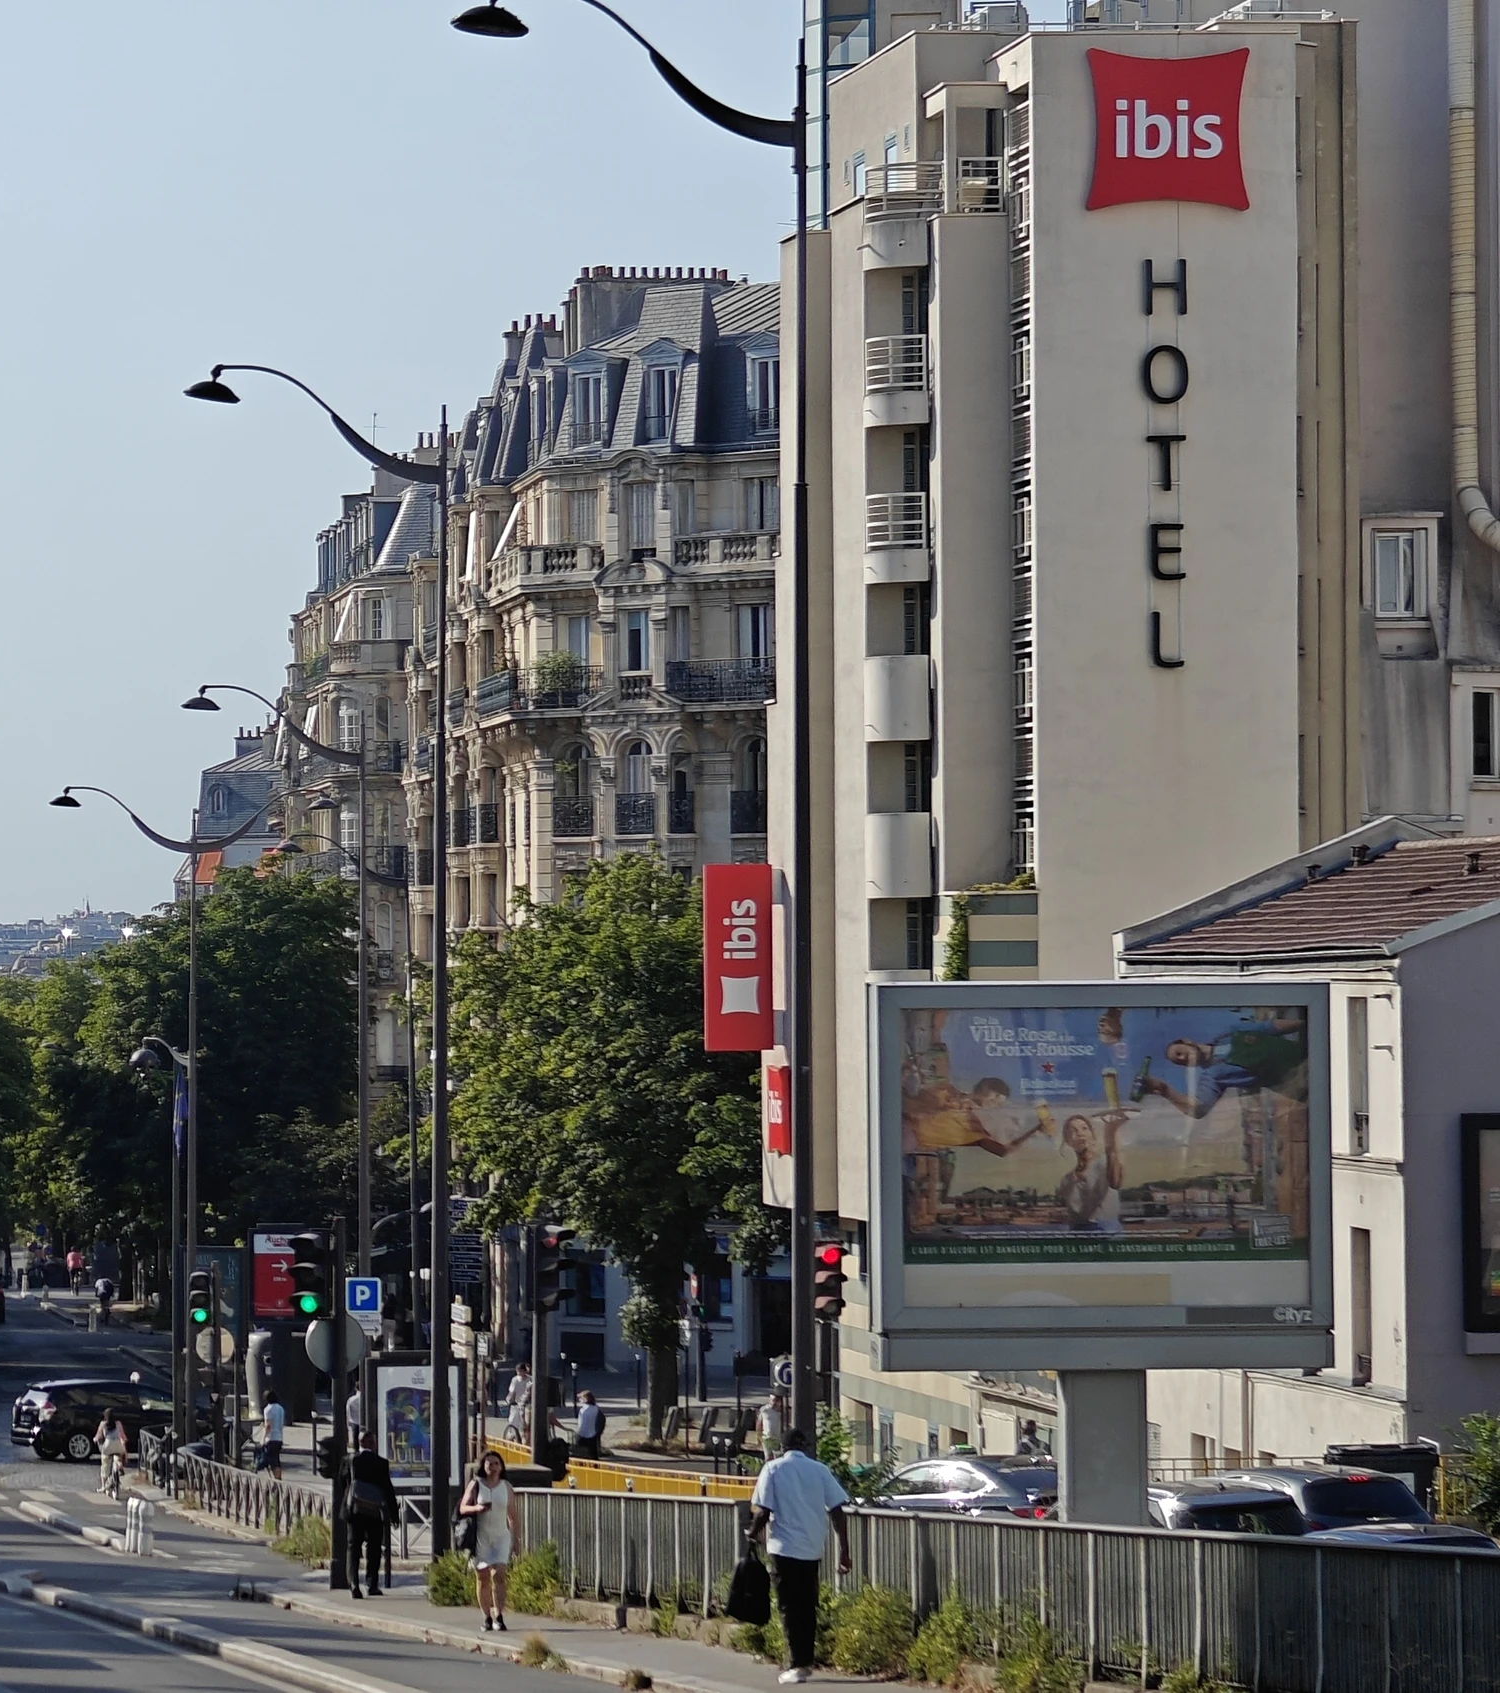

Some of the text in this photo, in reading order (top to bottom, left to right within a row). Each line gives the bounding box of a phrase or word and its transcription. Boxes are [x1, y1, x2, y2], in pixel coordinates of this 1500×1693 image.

[1114, 99, 1223, 159] ibis
[1142, 258, 1188, 668] HOTEL
[723, 899, 756, 960] ibis
[970, 1026, 1014, 1042] Ville
[1018, 1028, 1056, 1042] Rose
[986, 1042, 1095, 1056] Croix-Rousse
[356, 1285, 370, 1306] P
